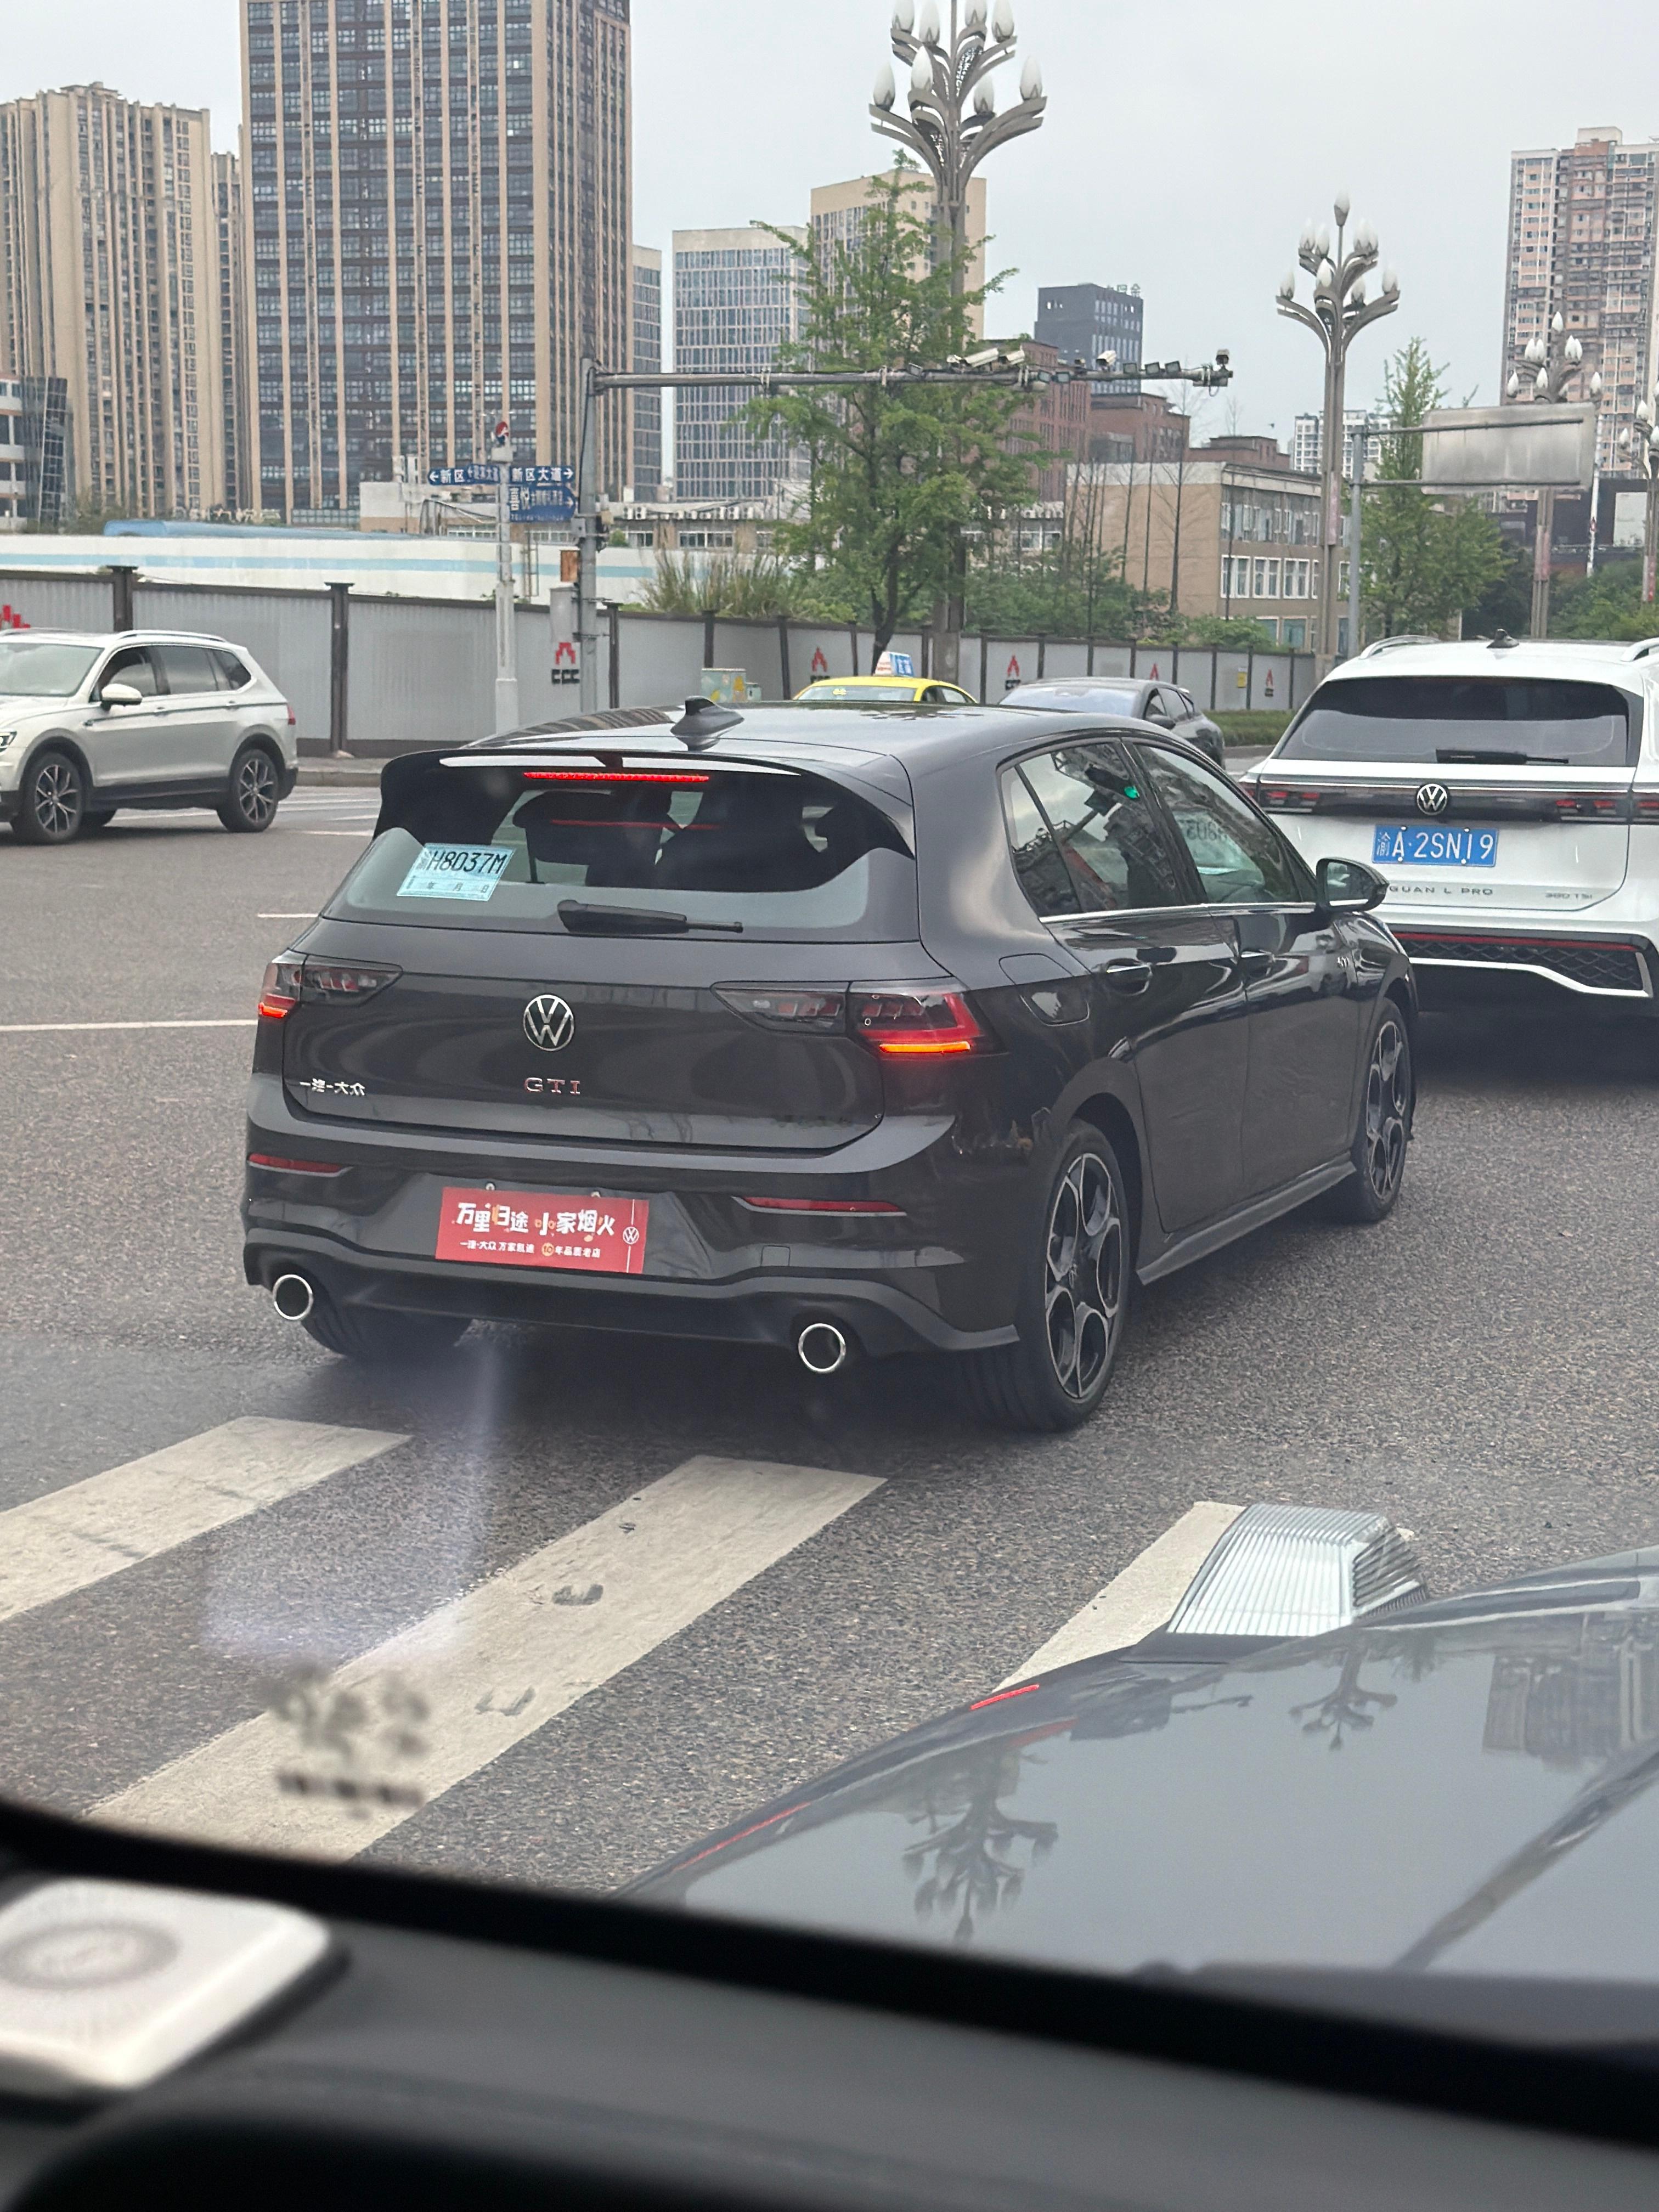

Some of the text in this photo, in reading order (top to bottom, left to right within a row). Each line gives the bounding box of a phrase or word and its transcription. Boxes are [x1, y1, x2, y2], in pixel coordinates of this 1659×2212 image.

[512, 467, 561, 482] 新区大道
[1389, 885, 1435, 894] GUAN
[1461, 887, 1493, 896] PRO
[524, 1077, 581, 1094] GTI
[534, 1209, 616, 1236] 小家烟火
